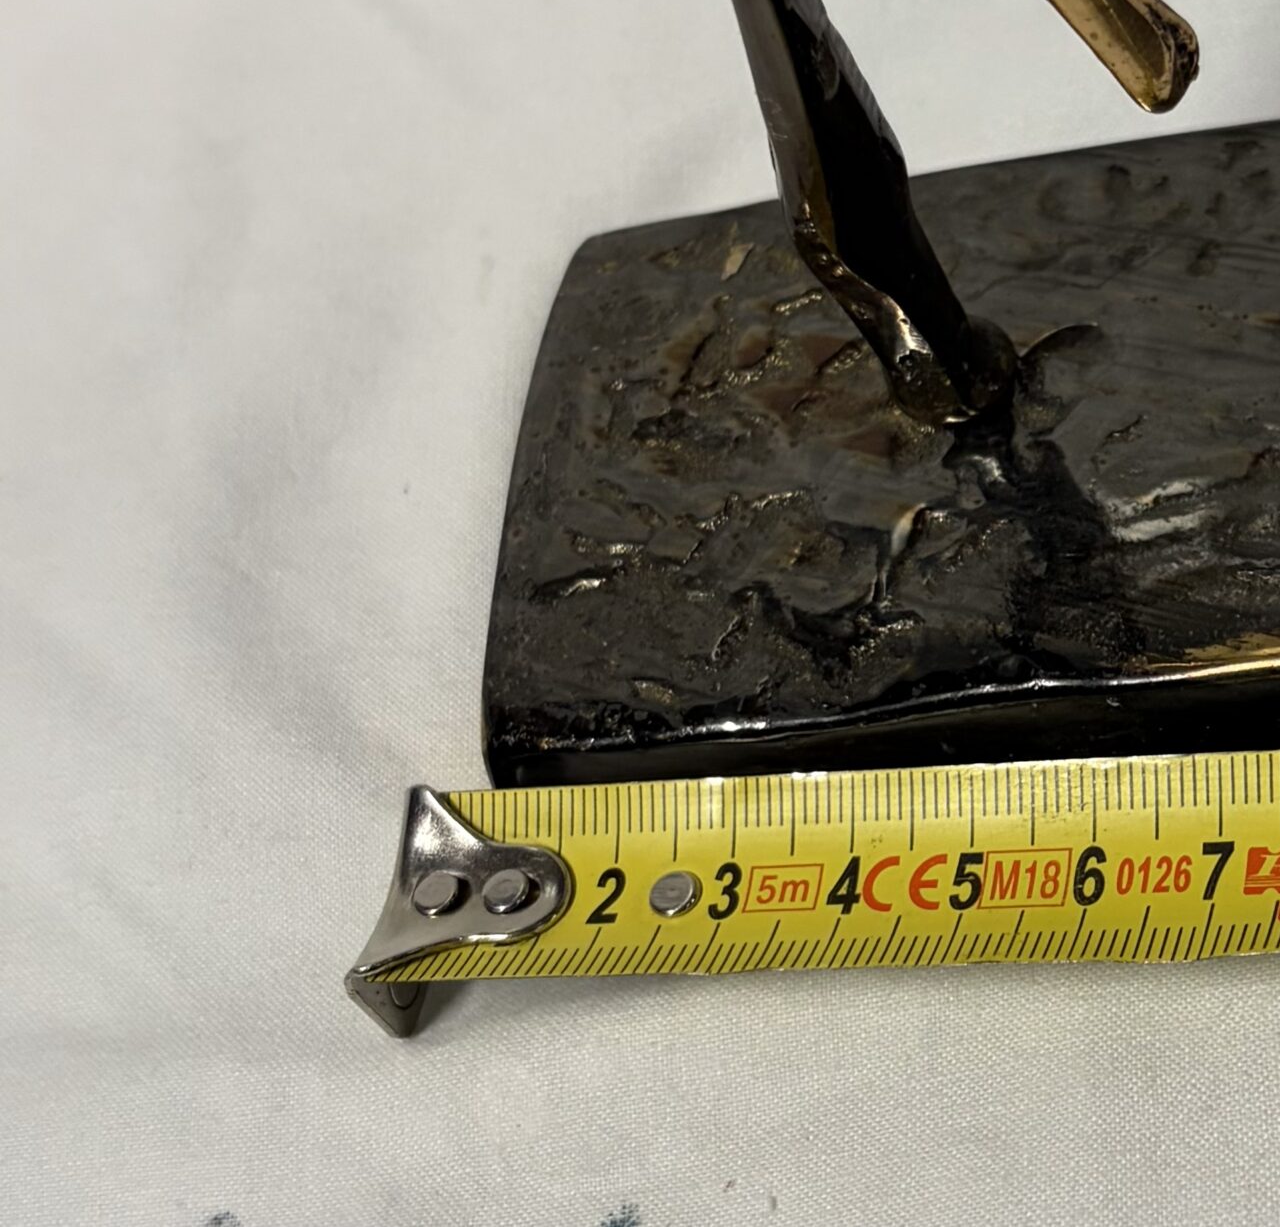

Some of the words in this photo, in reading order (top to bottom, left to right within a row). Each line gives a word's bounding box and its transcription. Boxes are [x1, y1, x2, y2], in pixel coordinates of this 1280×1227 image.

[587, 867, 626, 924] 2
[708, 862, 742, 920] 3
[756, 874, 811, 904] 5m
[826, 857, 862, 915] 4
[949, 853, 984, 910] 5
[990, 860, 1061, 899] M18
[1073, 845, 1106, 906] 6
[1117, 855, 1192, 895] 0126
[1201, 841, 1235, 901] 7
